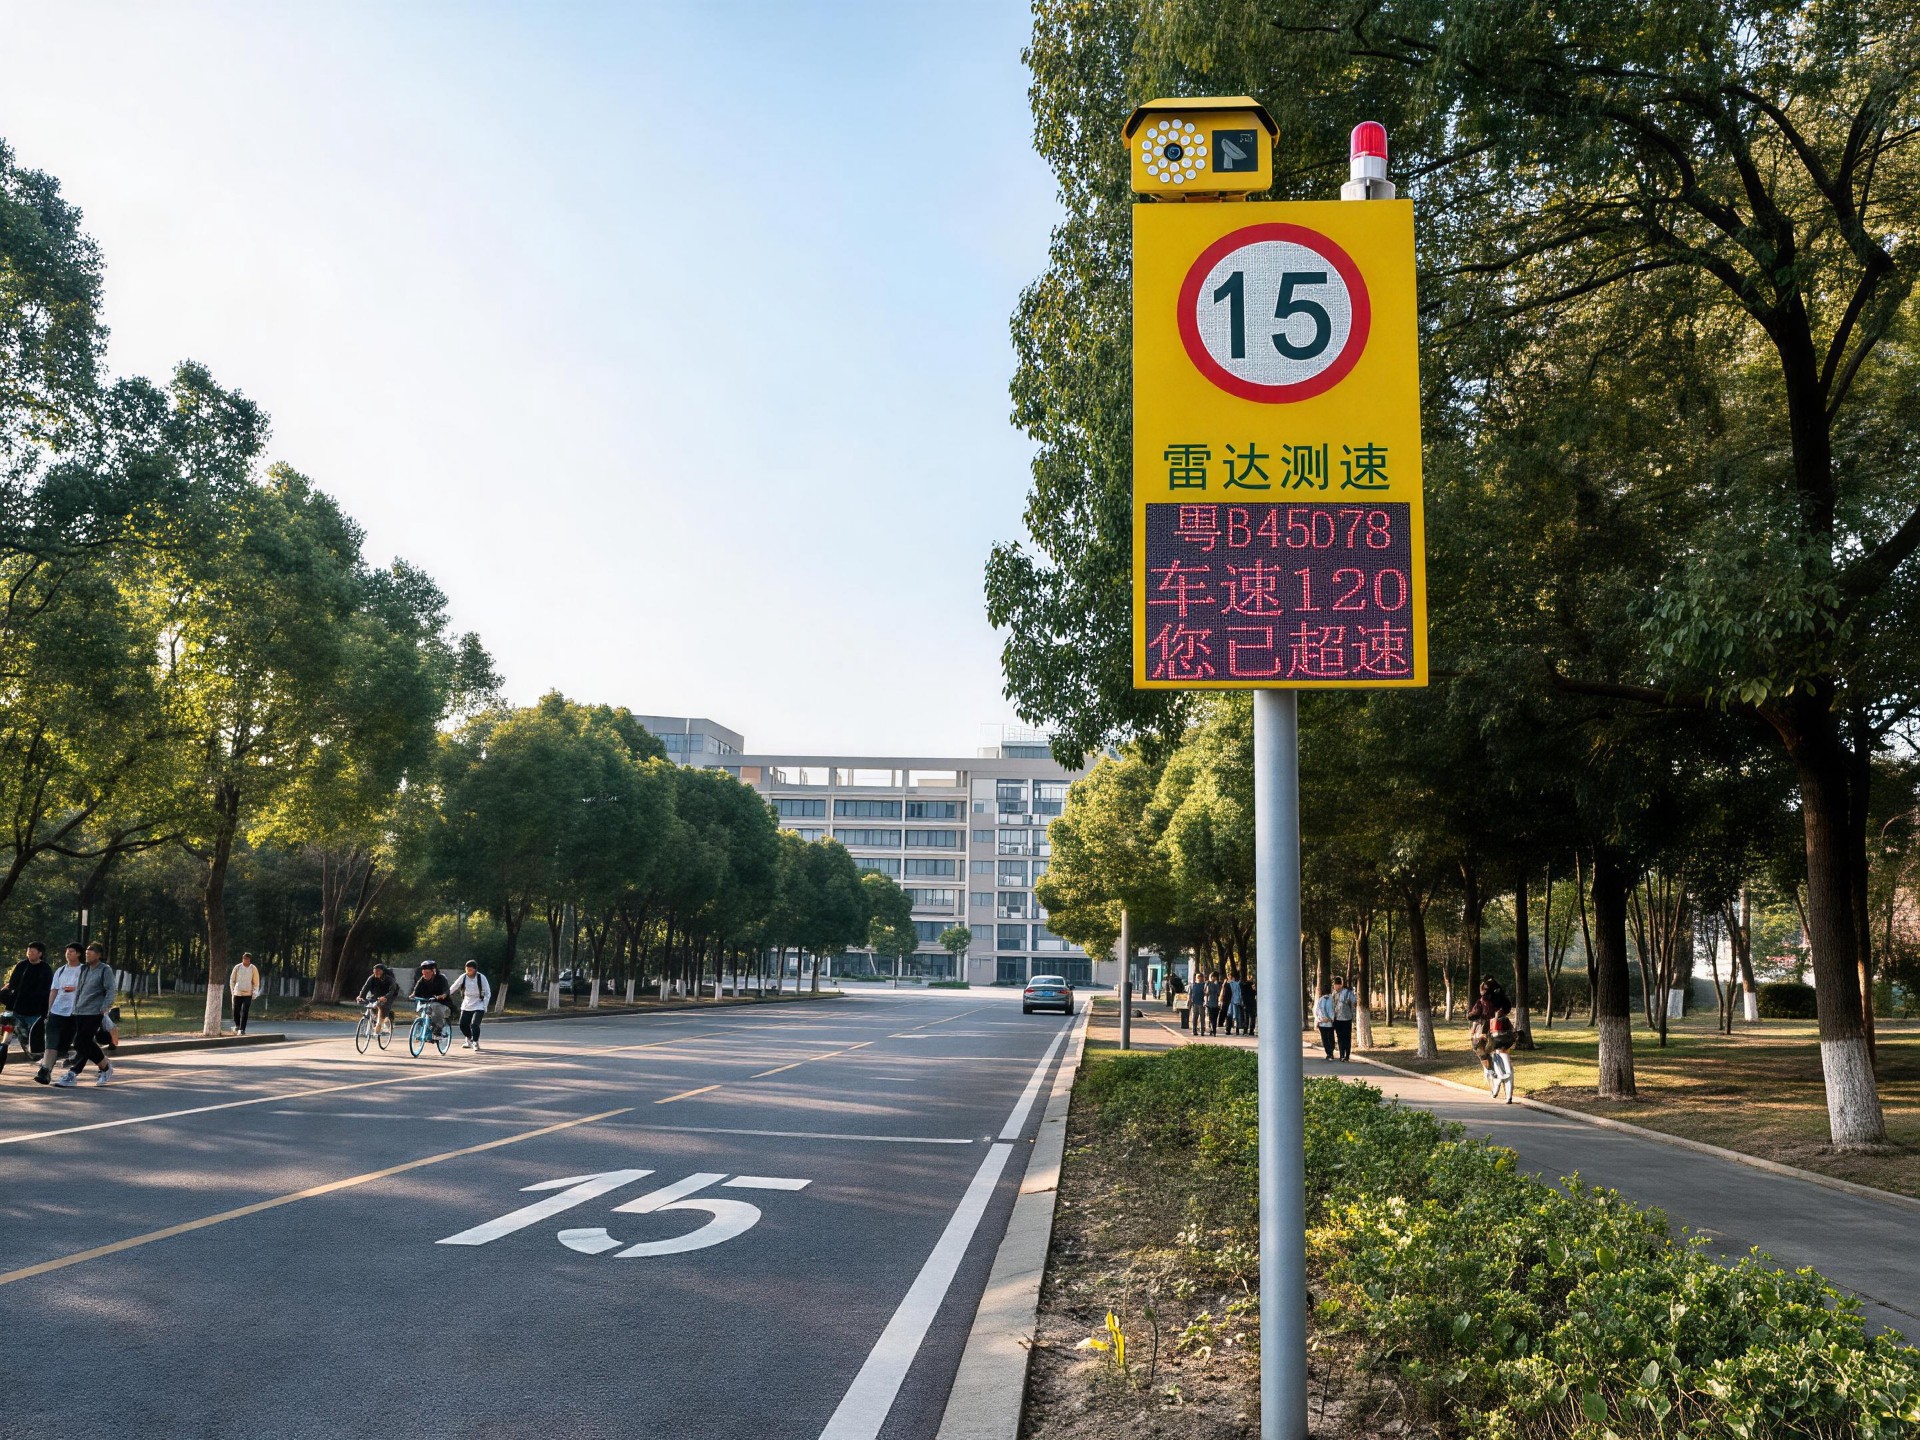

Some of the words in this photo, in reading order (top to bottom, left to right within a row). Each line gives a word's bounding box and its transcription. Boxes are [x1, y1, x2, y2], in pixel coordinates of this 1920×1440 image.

[1213, 271, 1332, 360] 15
[1163, 442, 1390, 491] 雷达测速
[1174, 505, 1392, 551] 粤B45D78
[1148, 559, 1410, 618] 车速120
[1149, 620, 1410, 680] 您已超速
[434, 1169, 813, 1258] 15
